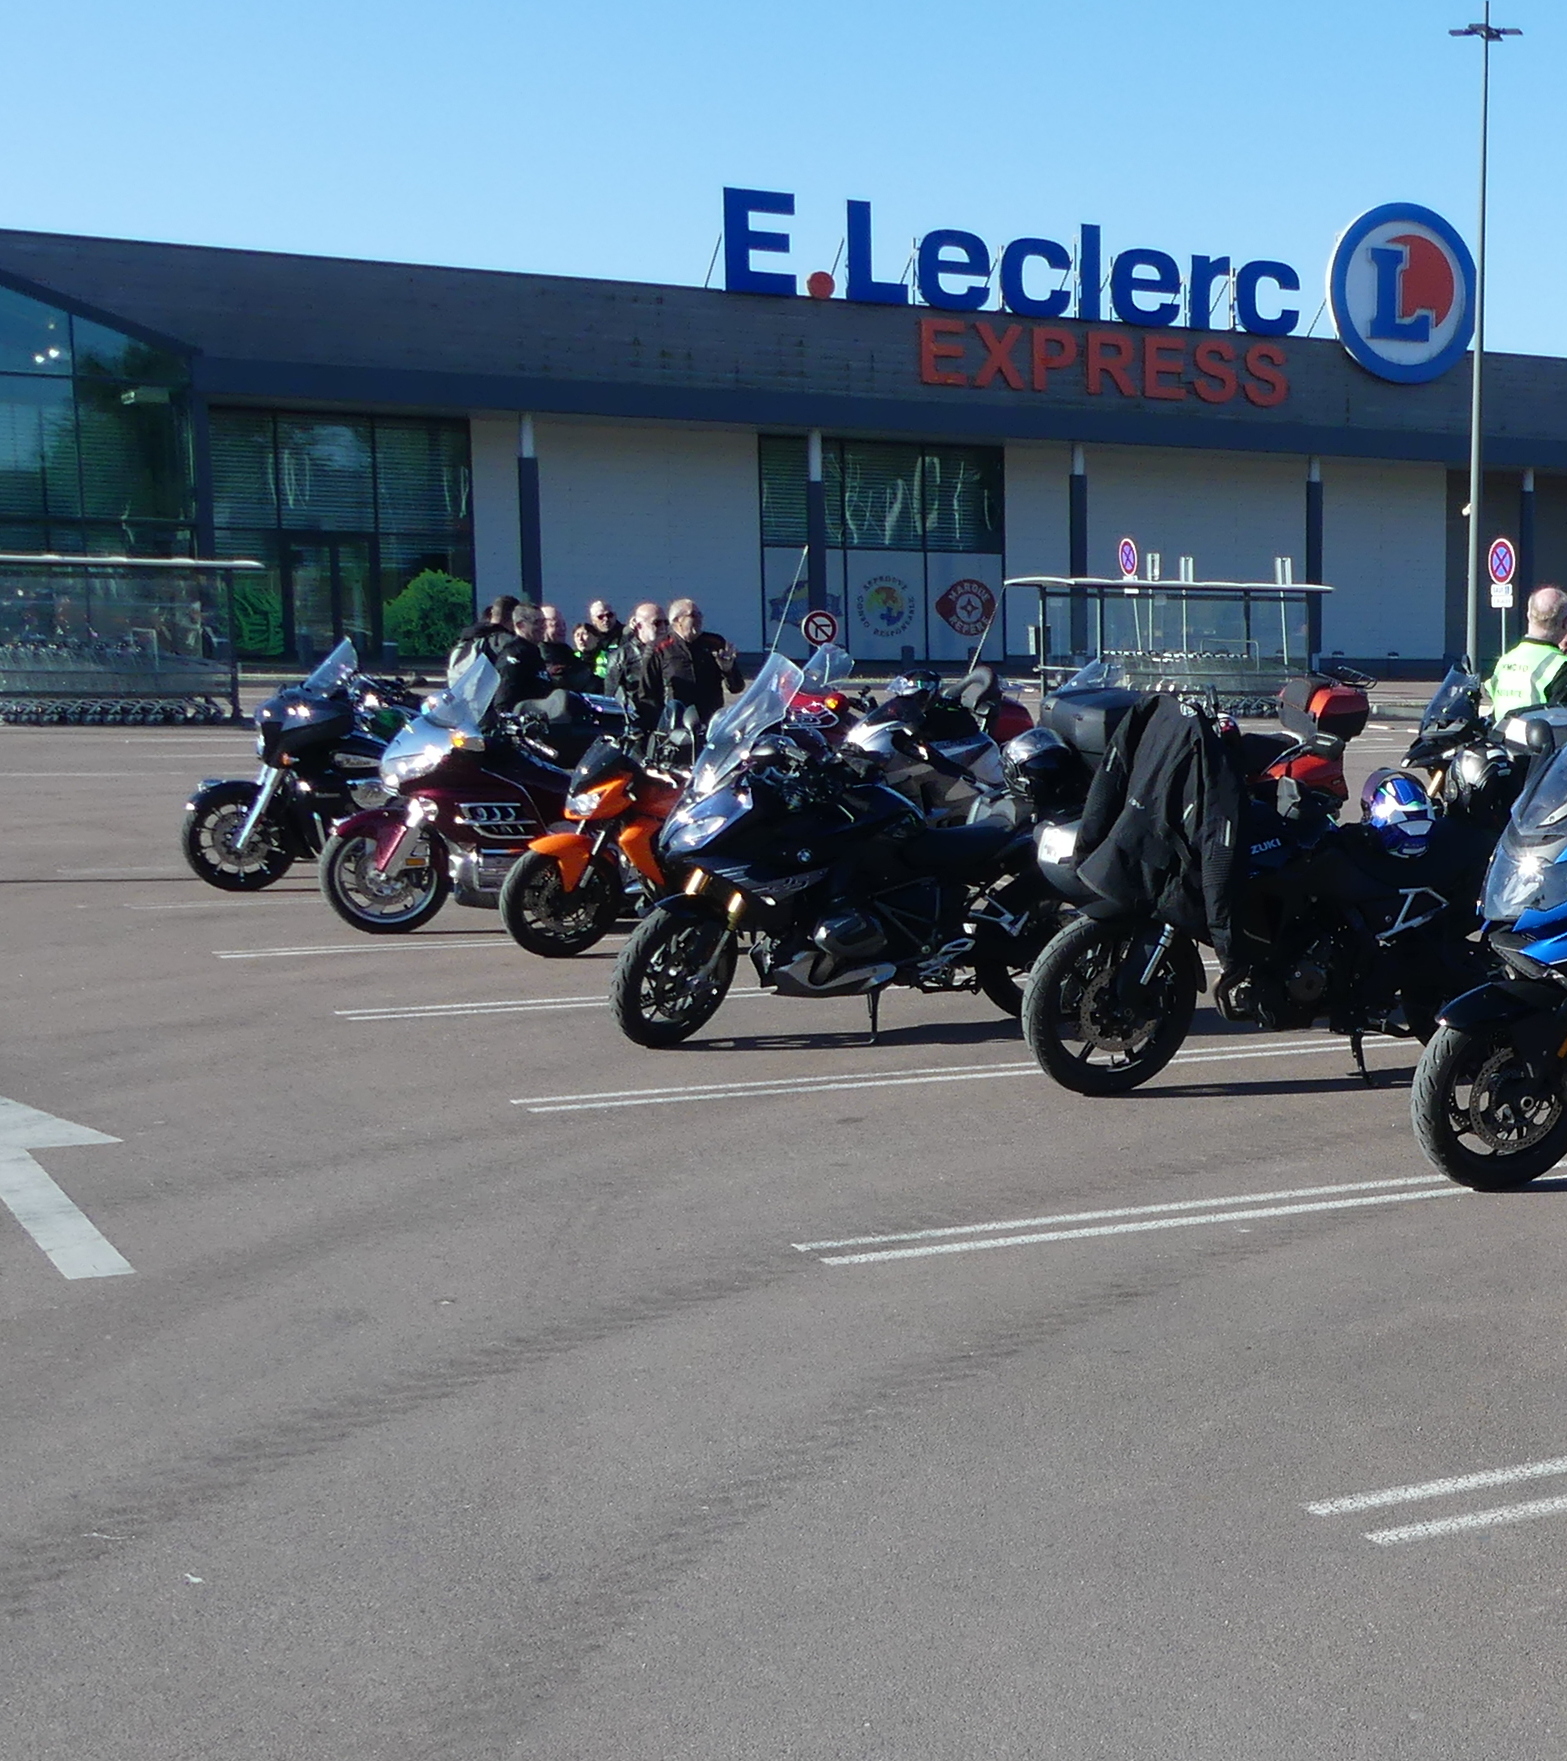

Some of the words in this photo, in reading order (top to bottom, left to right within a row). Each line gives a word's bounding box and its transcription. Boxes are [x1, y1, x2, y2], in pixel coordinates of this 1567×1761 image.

[723, 187, 1300, 337] E.Leclerc
[919, 317, 1290, 408] EXPRESS
[948, 582, 991, 602] MARQUE
[1250, 838, 1281, 855] ZUKI
